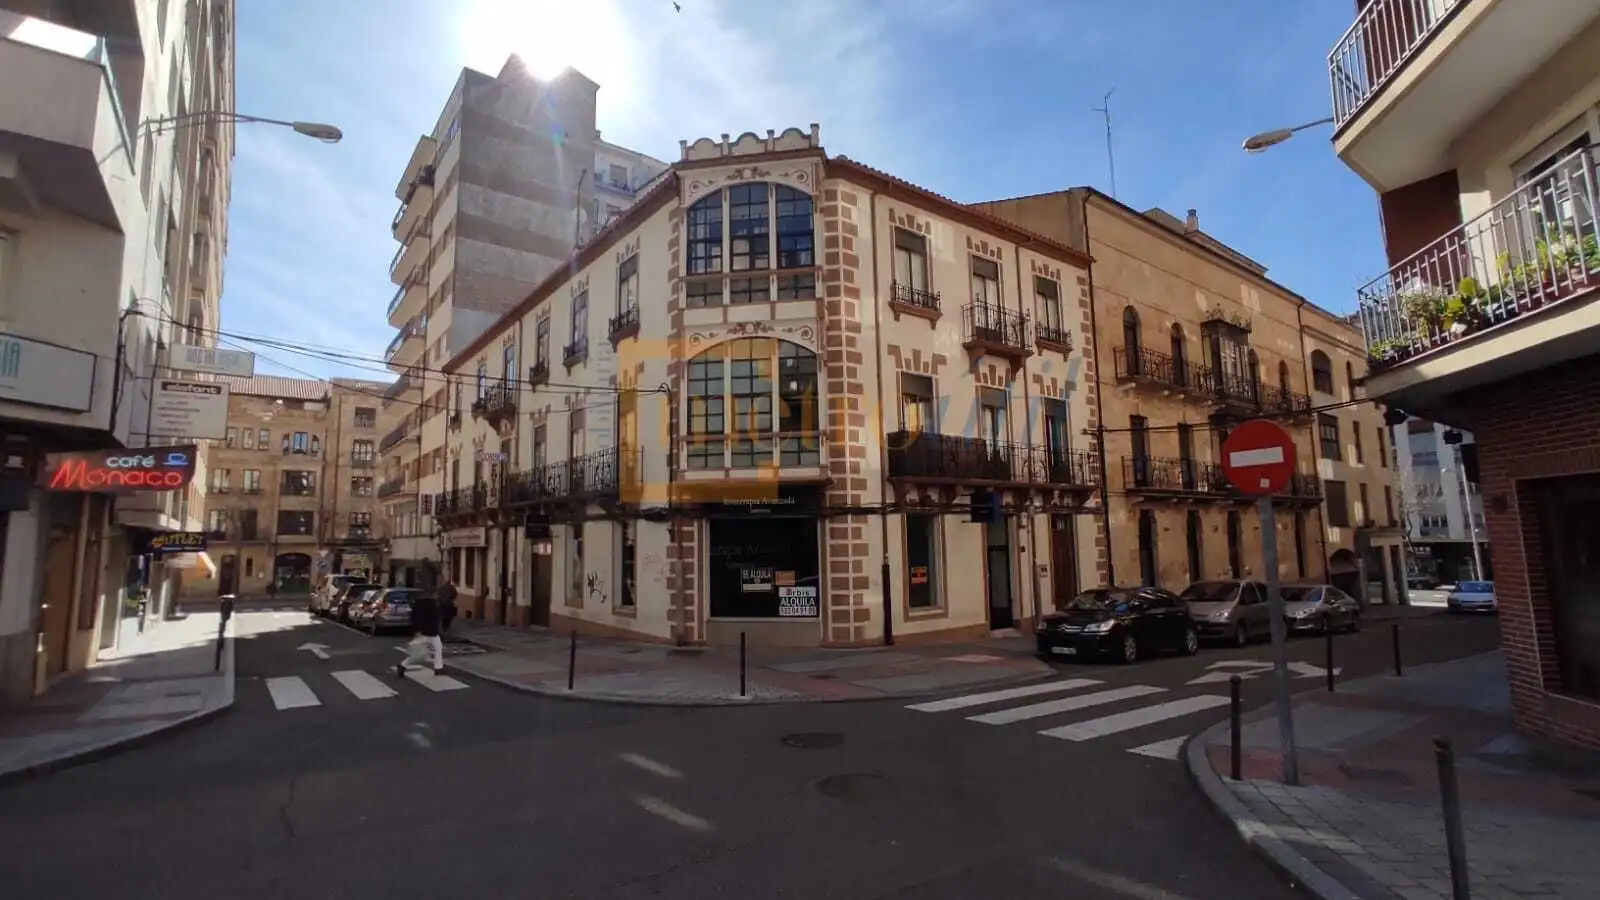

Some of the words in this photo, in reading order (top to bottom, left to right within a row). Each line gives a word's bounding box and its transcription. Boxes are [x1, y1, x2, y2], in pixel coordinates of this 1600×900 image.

[106, 454, 155, 468] café
[50, 458, 183, 489] Monaco
[781, 597, 815, 606] ALQUILA
